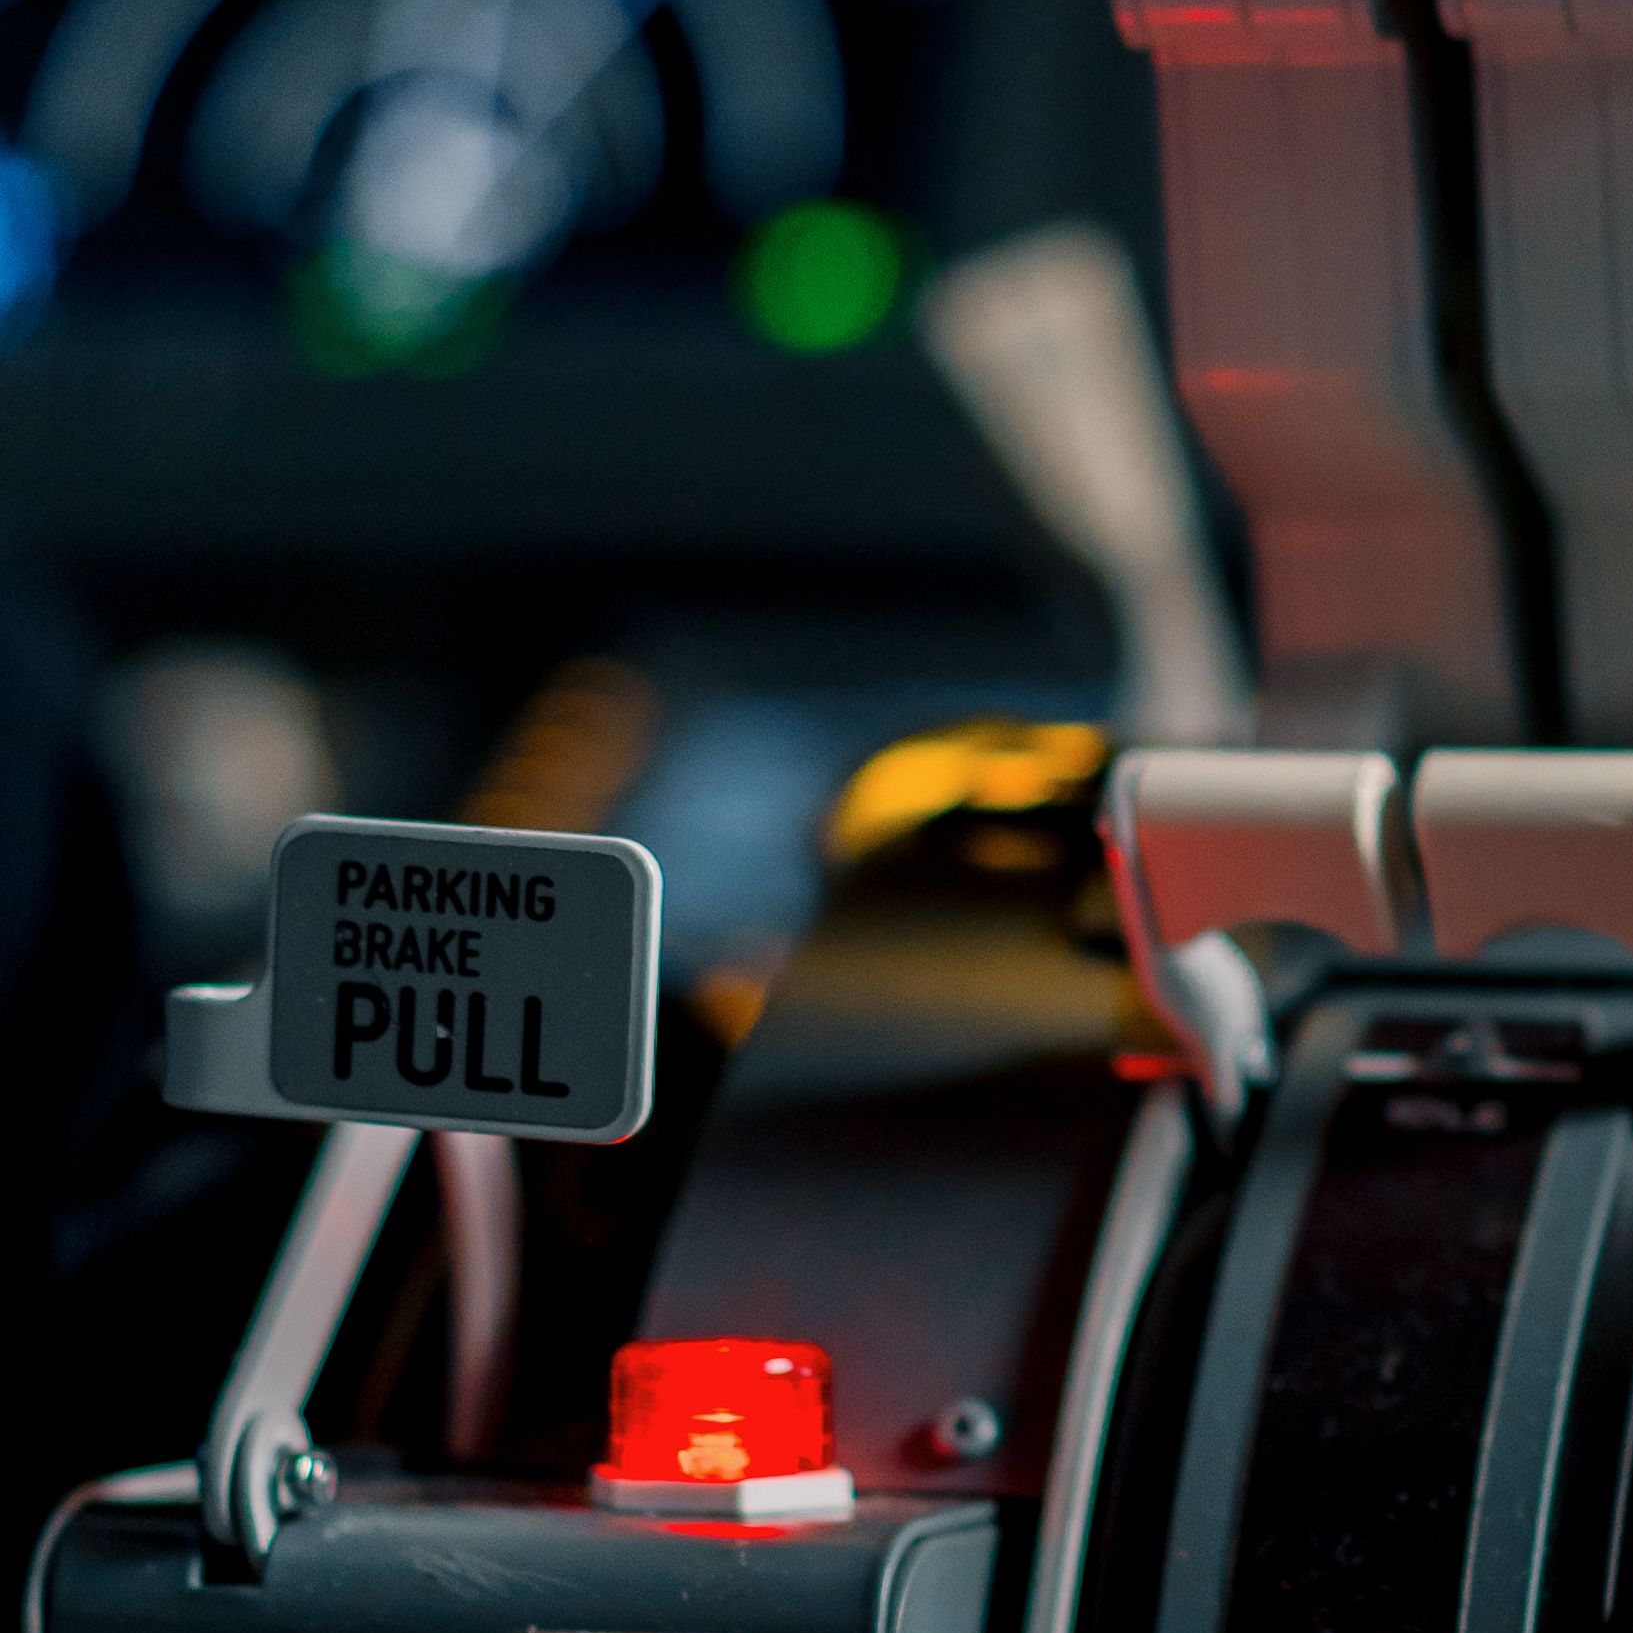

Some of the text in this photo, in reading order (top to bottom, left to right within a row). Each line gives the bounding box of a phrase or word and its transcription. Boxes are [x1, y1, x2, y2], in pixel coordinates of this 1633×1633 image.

[335, 860, 556, 922] PARKING
[333, 920, 482, 978] BRAKE
[333, 980, 570, 1098] PULL
